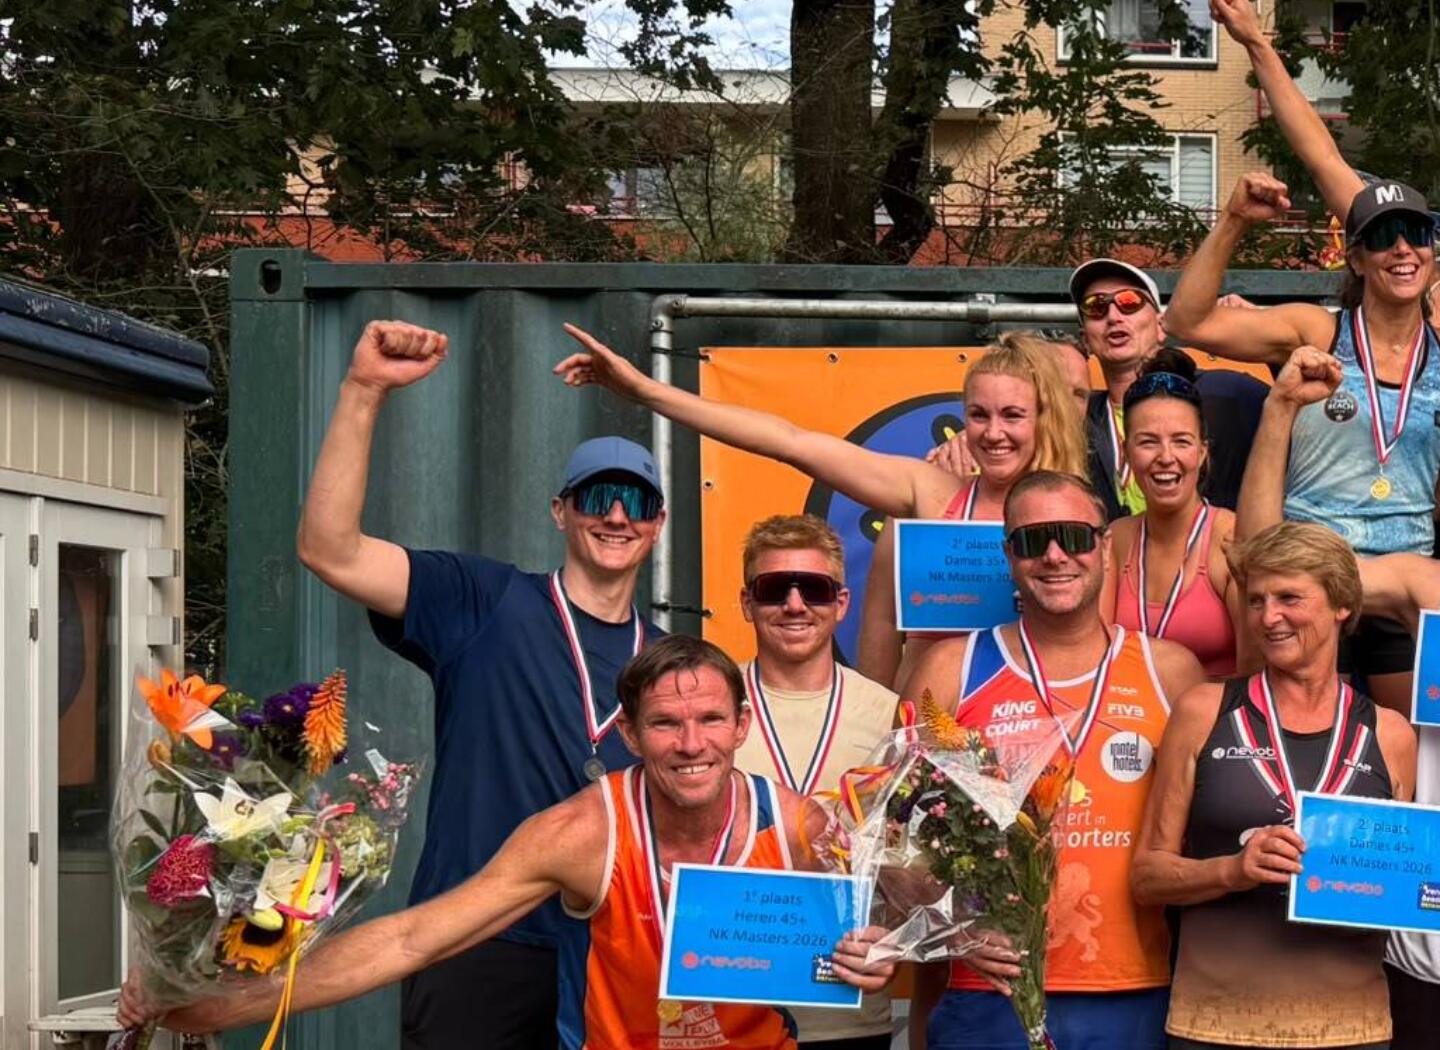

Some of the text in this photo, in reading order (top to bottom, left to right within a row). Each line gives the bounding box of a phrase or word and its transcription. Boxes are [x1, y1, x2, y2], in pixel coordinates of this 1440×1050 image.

[992, 699, 1037, 719] KING
[985, 719, 1041, 738] COURT
[1373, 821, 1410, 835] plaats
[1350, 837, 1415, 854] Dames 45+
[1329, 853, 1432, 875] NK Masters 2026
[759, 892, 802, 906] plaats
[734, 910, 806, 926] Heren 45+
[708, 928, 828, 947] NK Masters 2026
